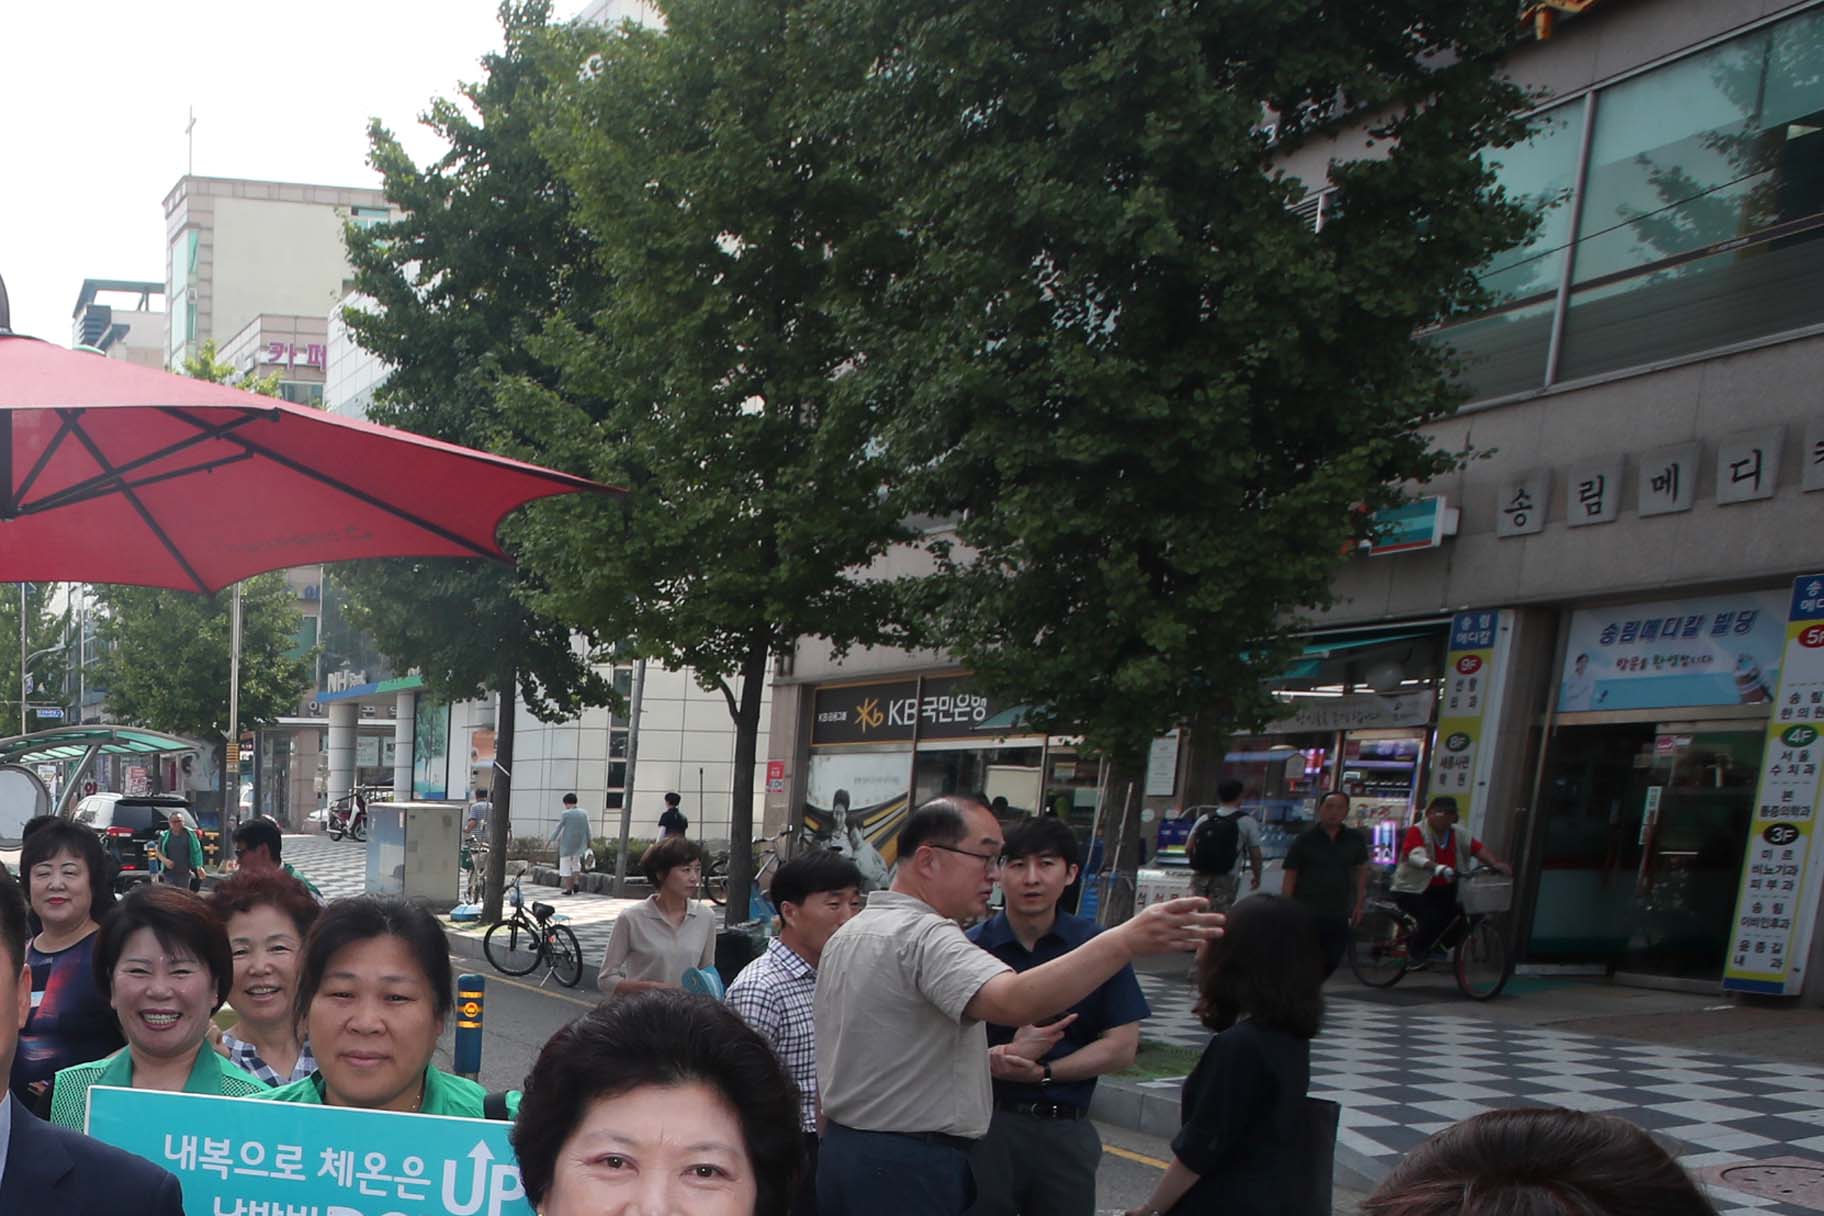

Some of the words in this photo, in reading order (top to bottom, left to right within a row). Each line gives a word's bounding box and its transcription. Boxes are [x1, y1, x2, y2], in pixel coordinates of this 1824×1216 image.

[888, 694, 988, 726] KB국민은행
[1788, 729, 1812, 742] 4F
[1770, 827, 1795, 841] 3F
[164, 1134, 306, 1182] 내복으로
[317, 1145, 432, 1201] 체온은
